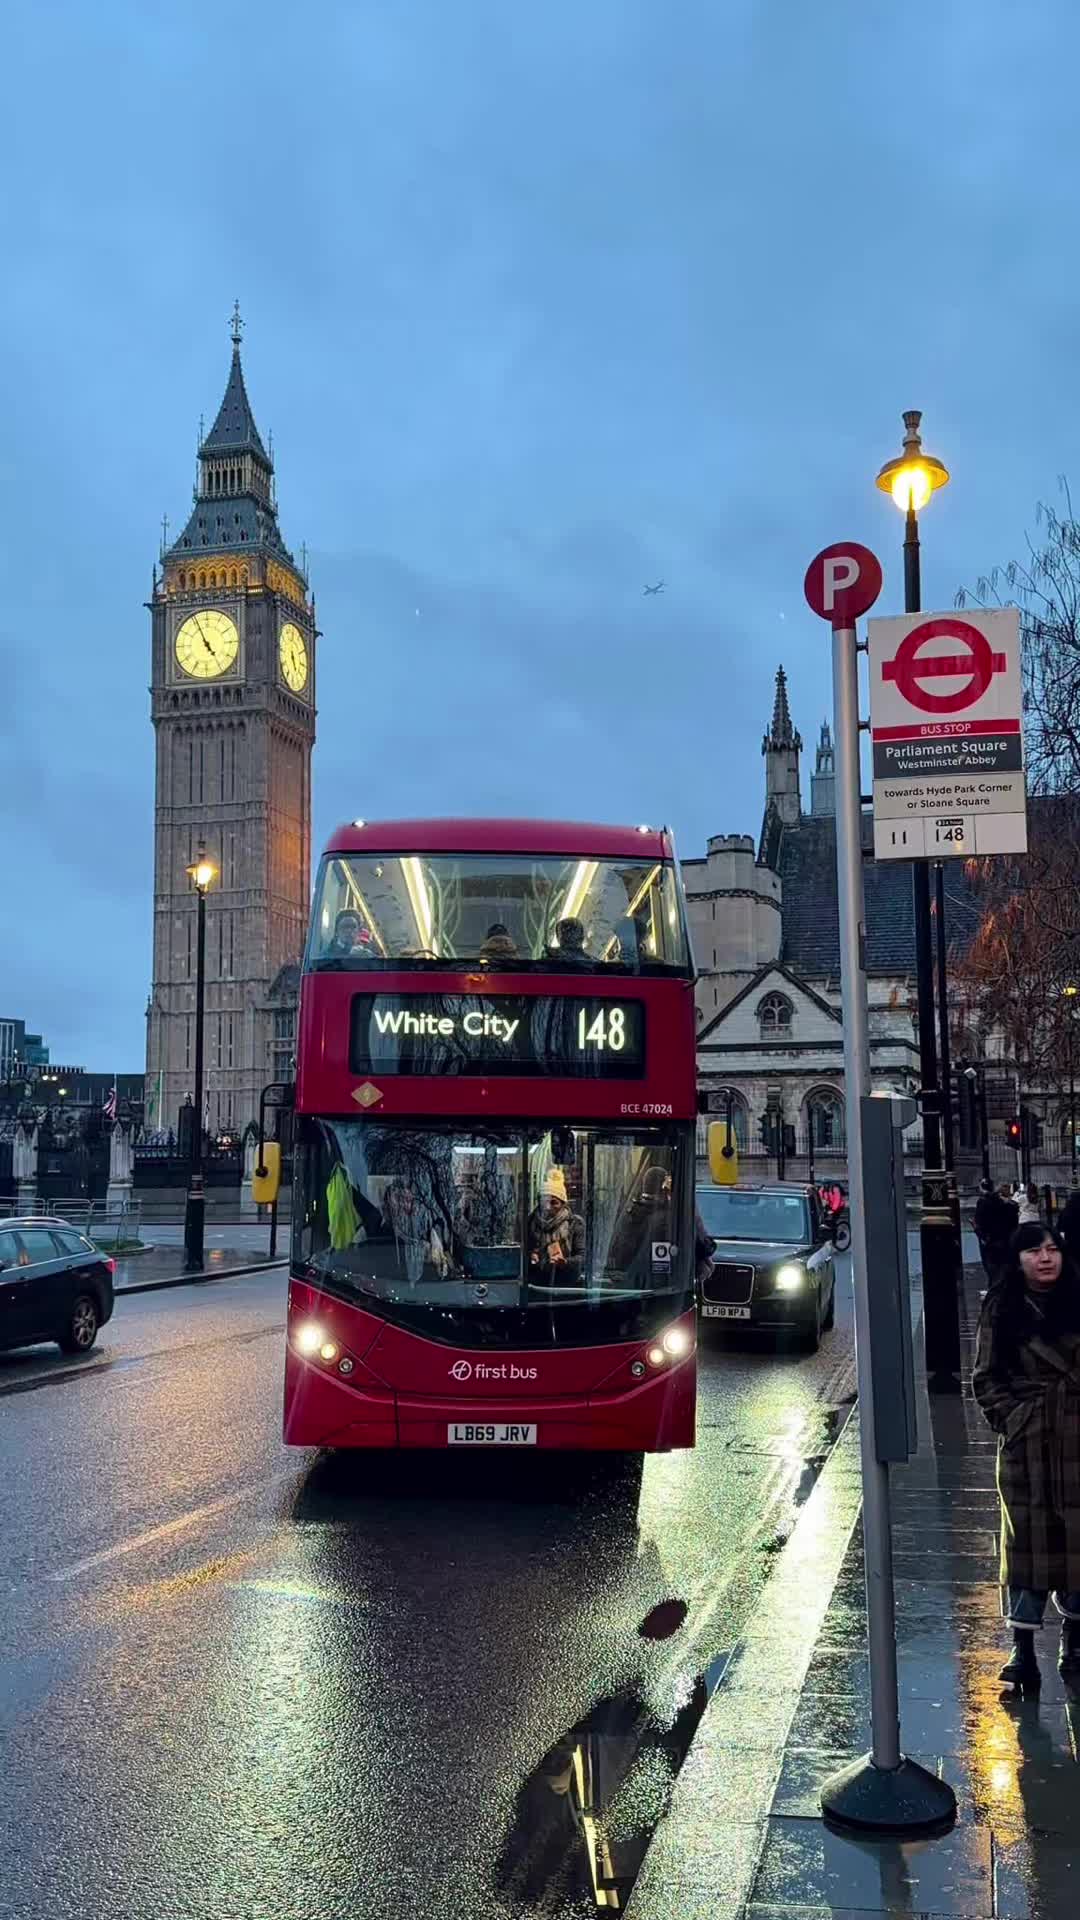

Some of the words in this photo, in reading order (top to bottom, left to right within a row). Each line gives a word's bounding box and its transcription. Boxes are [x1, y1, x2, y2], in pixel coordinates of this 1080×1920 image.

[823, 556, 860, 611] P
[920, 724, 942, 735] BUS
[944, 723, 971, 733] STOP
[886, 743, 958, 758] Parliament
[961, 741, 1008, 754] Square
[897, 757, 961, 769] Westminster
[965, 755, 996, 765] Abbey
[884, 787, 924, 798] towards
[926, 786, 952, 796] Hyde
[954, 785, 975, 793] Park
[978, 783, 1012, 792] Corner
[920, 799, 953, 808] Sloane
[956, 797, 990, 807] Square
[892, 830, 907, 844] 11
[936, 827, 964, 842] 148
[374, 1010, 454, 1035] White
[463, 1012, 520, 1041] City
[578, 1007, 625, 1051] 148
[620, 1103, 641, 1114] BCE
[642, 1103, 673, 1114] 47024
[474, 1363, 507, 1379] first
[510, 1363, 537, 1379] bus
[454, 1425, 495, 1441] LB69
[500, 1426, 530, 1442] JRV
